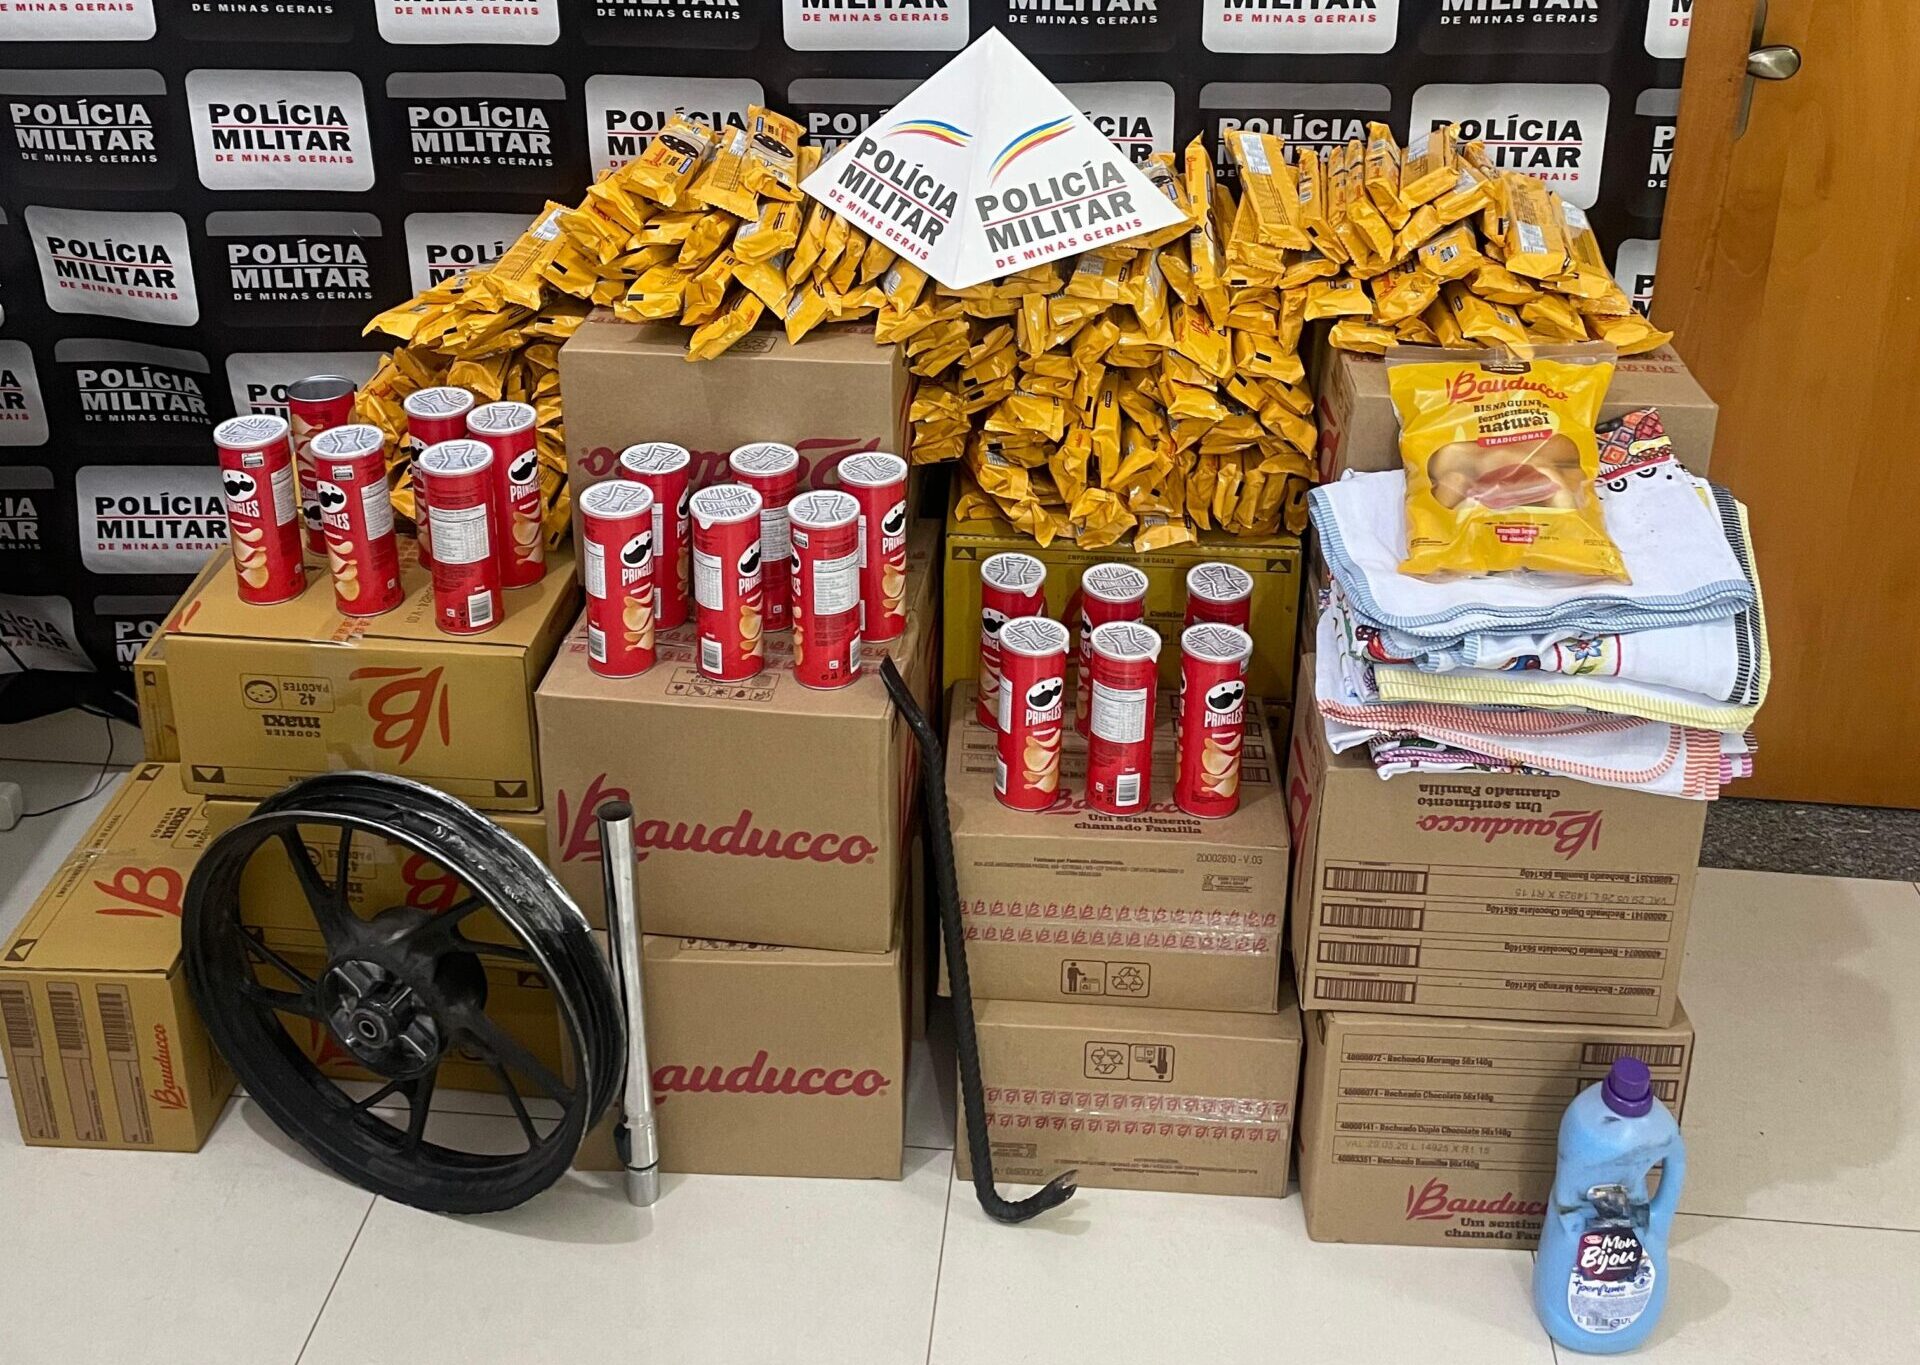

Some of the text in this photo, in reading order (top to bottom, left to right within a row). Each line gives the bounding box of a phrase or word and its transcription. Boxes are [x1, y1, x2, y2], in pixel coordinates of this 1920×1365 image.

[16, 3, 68, 11] MINAS
[75, 3, 134, 11] GERAIS
[192, 3, 334, 14] DE MINAS GERAIS
[394, 6, 540, 15] DE MINAS GERAIS
[597, 8, 741, 20] DE MINAS GERAIS
[802, 13, 950, 22] DE MINAS GERAIS
[1009, 15, 1158, 25] DE MINAS GERAIS
[1223, 14, 1377, 23] DE MINAS GERAIS
[1441, 14, 1598, 24] DE MINAS GERAIS
[9, 99, 152, 125] POLÍCIA
[208, 100, 348, 126] POLÍCIA
[407, 101, 549, 129] POLÍCIA
[14, 128, 156, 151] MILITAR
[212, 129, 351, 151] MILITAR
[410, 131, 552, 154] MILITAR
[21, 152, 158, 164] DE MINAS GERAIS
[215, 154, 354, 164] DE MINAS GERAIS
[413, 156, 554, 167] DE MINAS GERAIS
[854, 137, 959, 219] POLÍCIA
[837, 163, 945, 247] MILITAR
[828, 188, 930, 260] DE MINAS GERAIS
[985, 191, 1136, 253] MILITAR
[47, 236, 172, 265] POLÍCIA
[228, 239, 367, 264] POLÍCIA
[995, 218, 1143, 269] DE MINAS GERAIS
[53, 259, 176, 289] MILITAR
[231, 268, 370, 289] MILITAR
[60, 280, 178, 300] DE MINAS GERAIS
[259, 292, 309, 300] MINAS
[316, 292, 373, 300] GERAIS
[76, 366, 202, 397] POLÍCIA
[1446, 370, 1568, 403] Bauducco
[80, 392, 207, 415] MILITAR
[85, 413, 212, 425] DE MINAS GERAIS
[1479, 416, 1550, 434] natural
[1485, 432, 1545, 446] TRADICIONAL
[95, 492, 225, 516] POLÍCIA
[98, 520, 227, 539] MILITAR
[282, 681, 329, 694] PACOTES
[299, 692, 316, 706] 42
[262, 714, 320, 728] maxi
[1204, 706, 1243, 728] PRINGLES
[265, 729, 321, 738] COOKIES
[1485, 786, 1561, 799] chamado
[1417, 797, 1543, 813] Um sentimento
[1074, 822, 1142, 832] chamado
[1416, 810, 1603, 861] Bauducco
[151, 1024, 188, 1110] Bauducco
[652, 1050, 891, 1098] auducco
[1460, 1218, 1541, 1229] Um sentim
[1445, 1229, 1513, 1240] chamado
[1602, 1234, 1638, 1250] Mon
[1581, 1246, 1638, 1275] Bijou
